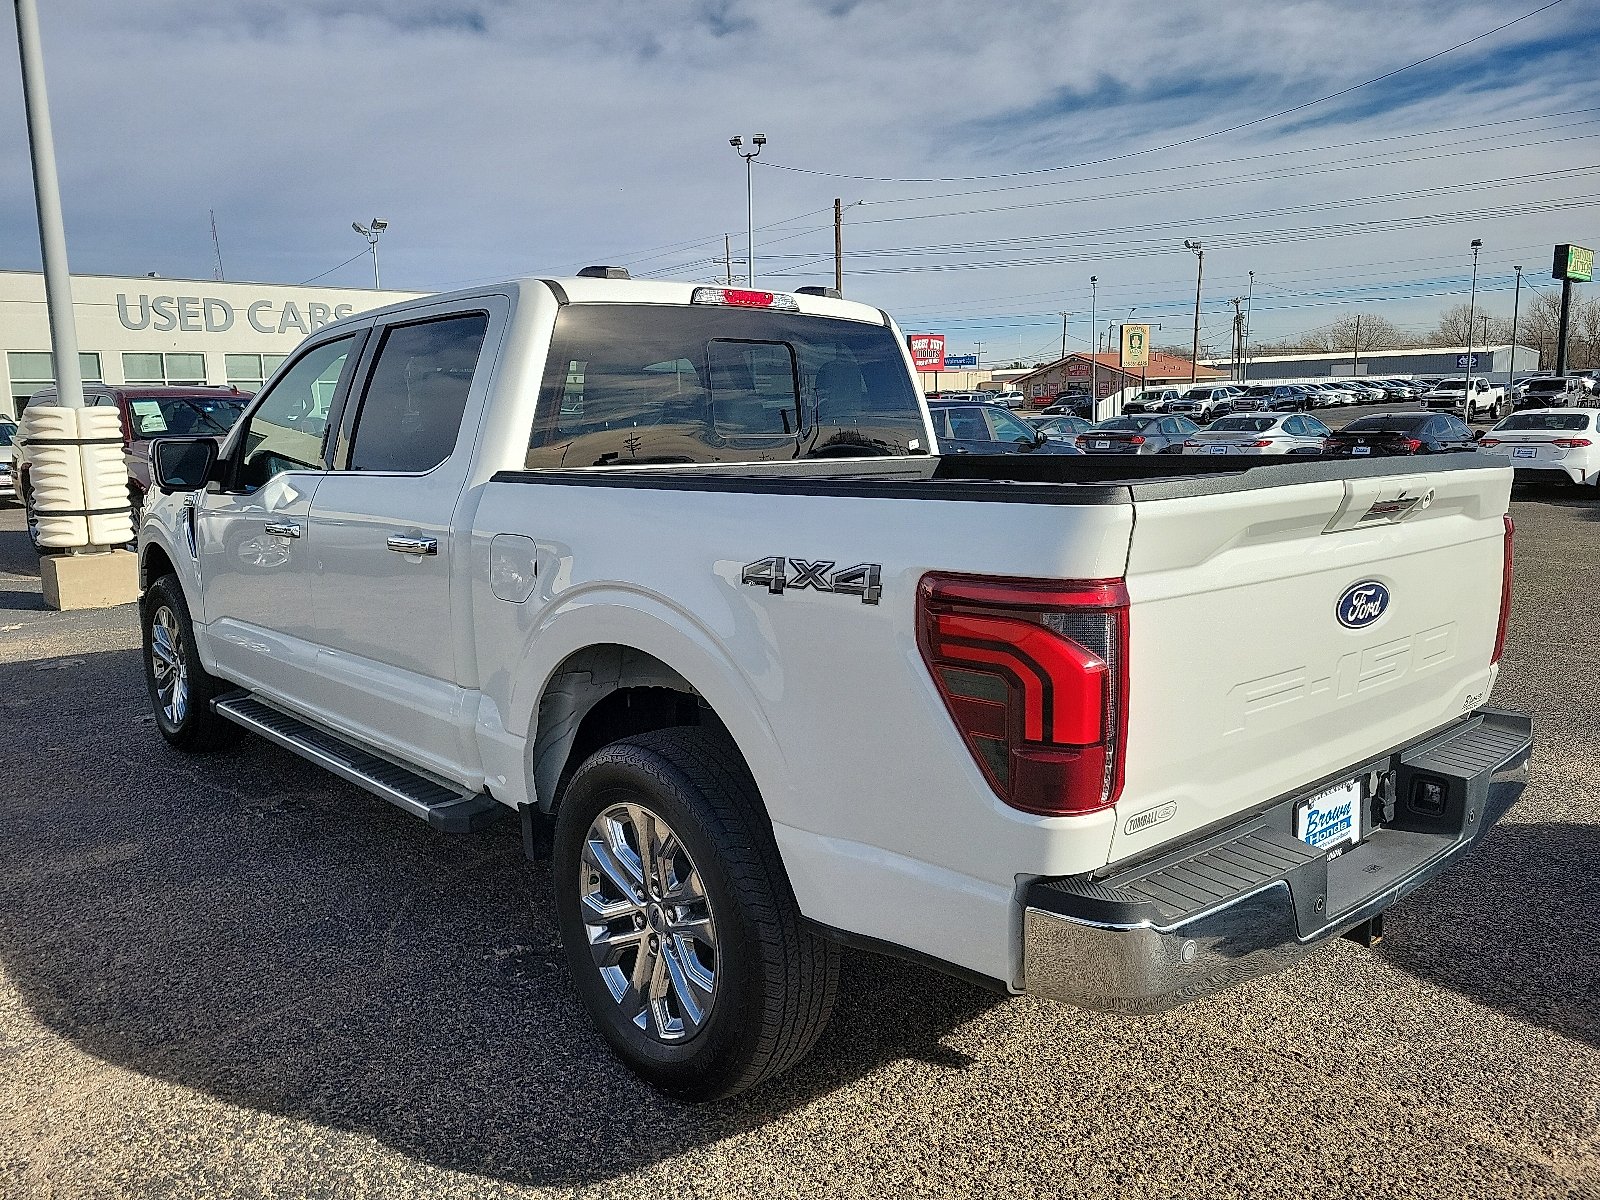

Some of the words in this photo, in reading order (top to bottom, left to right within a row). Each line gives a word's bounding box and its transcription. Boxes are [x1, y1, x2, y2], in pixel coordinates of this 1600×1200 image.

[116, 293, 235, 333] USED
[944, 357, 966, 366] Walmart
[1347, 588, 1383, 622] Ford
[1223, 620, 1459, 736] F-150
[1129, 810, 1157, 831] TOMBALL
[1306, 800, 1352, 836] Brown
[1309, 819, 1349, 846] Honda
